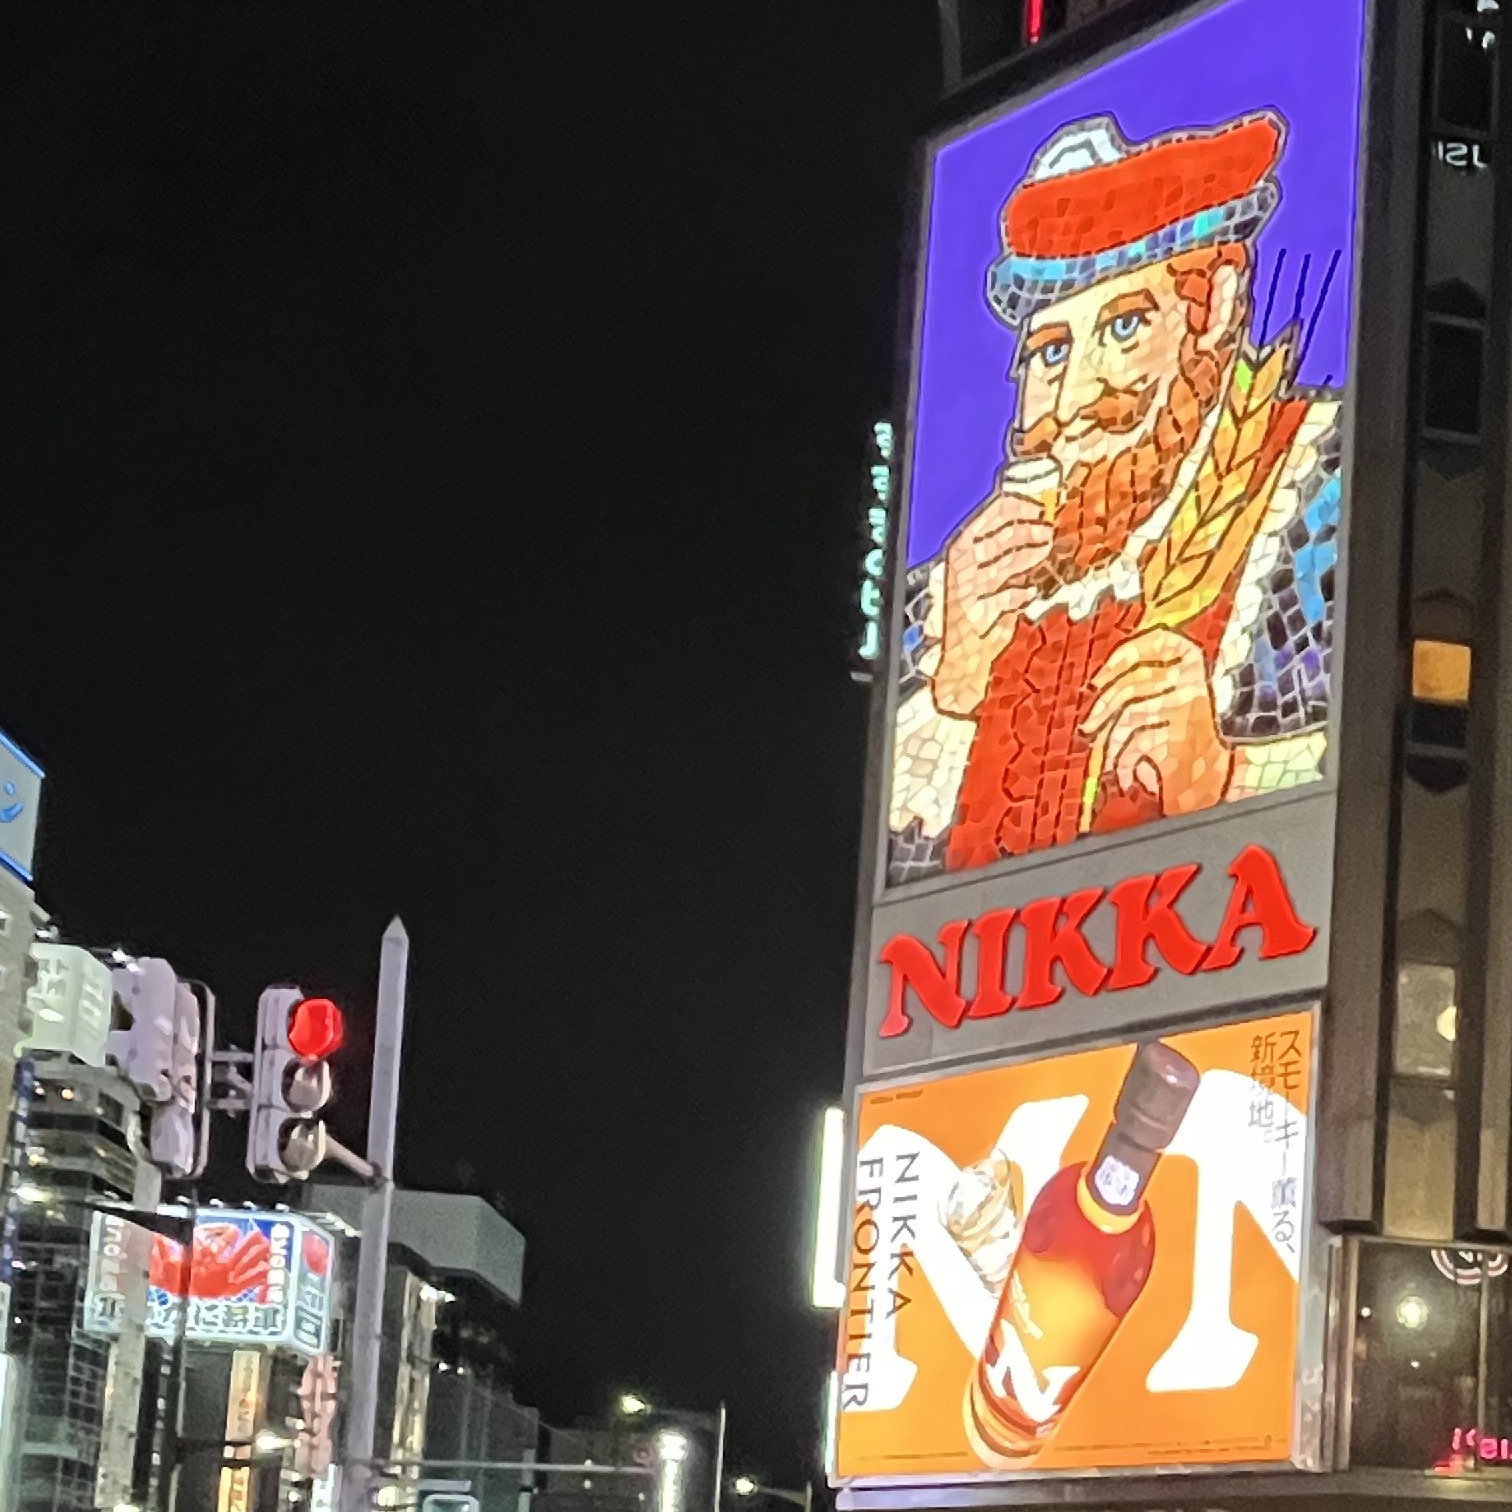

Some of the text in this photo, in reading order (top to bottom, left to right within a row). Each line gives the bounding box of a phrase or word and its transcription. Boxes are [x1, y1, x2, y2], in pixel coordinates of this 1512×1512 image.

[877, 843, 1317, 1037] NIKKA
[842, 1156, 884, 1409] FRONTIER
[886, 1151, 921, 1319] NIKKA
